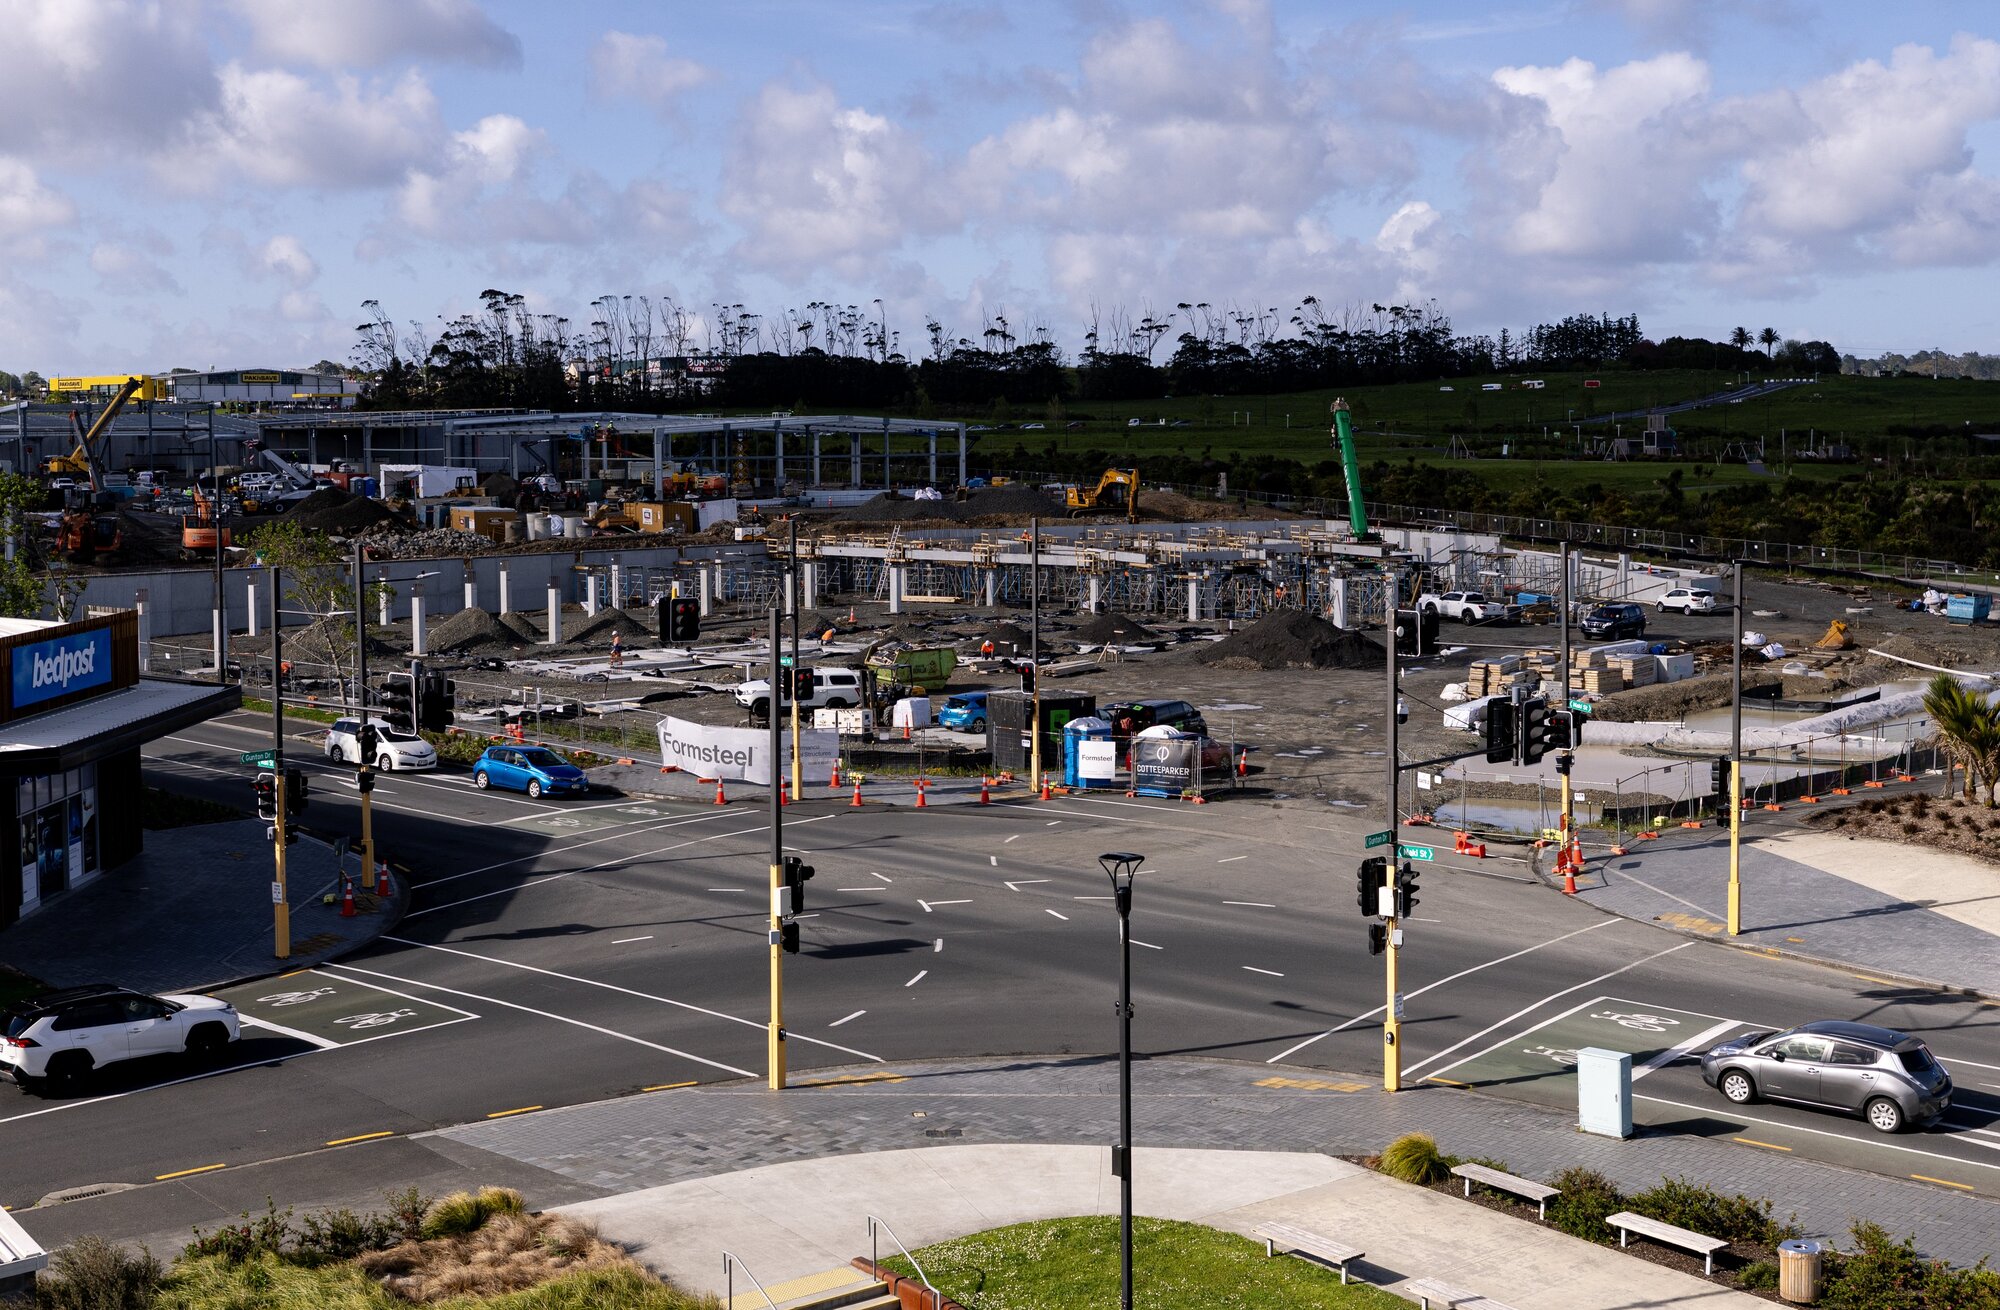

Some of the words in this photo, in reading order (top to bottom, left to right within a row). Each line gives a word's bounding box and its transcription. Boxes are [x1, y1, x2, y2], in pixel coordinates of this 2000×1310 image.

[32, 640, 95, 688] bedpost
[663, 731, 753, 767] Formsteel
[245, 753, 264, 761] Gunton
[1081, 754, 1113, 762] Formsteel
[1136, 764, 1190, 776] COTTEEPARKER
[1419, 849, 1427, 858] St
